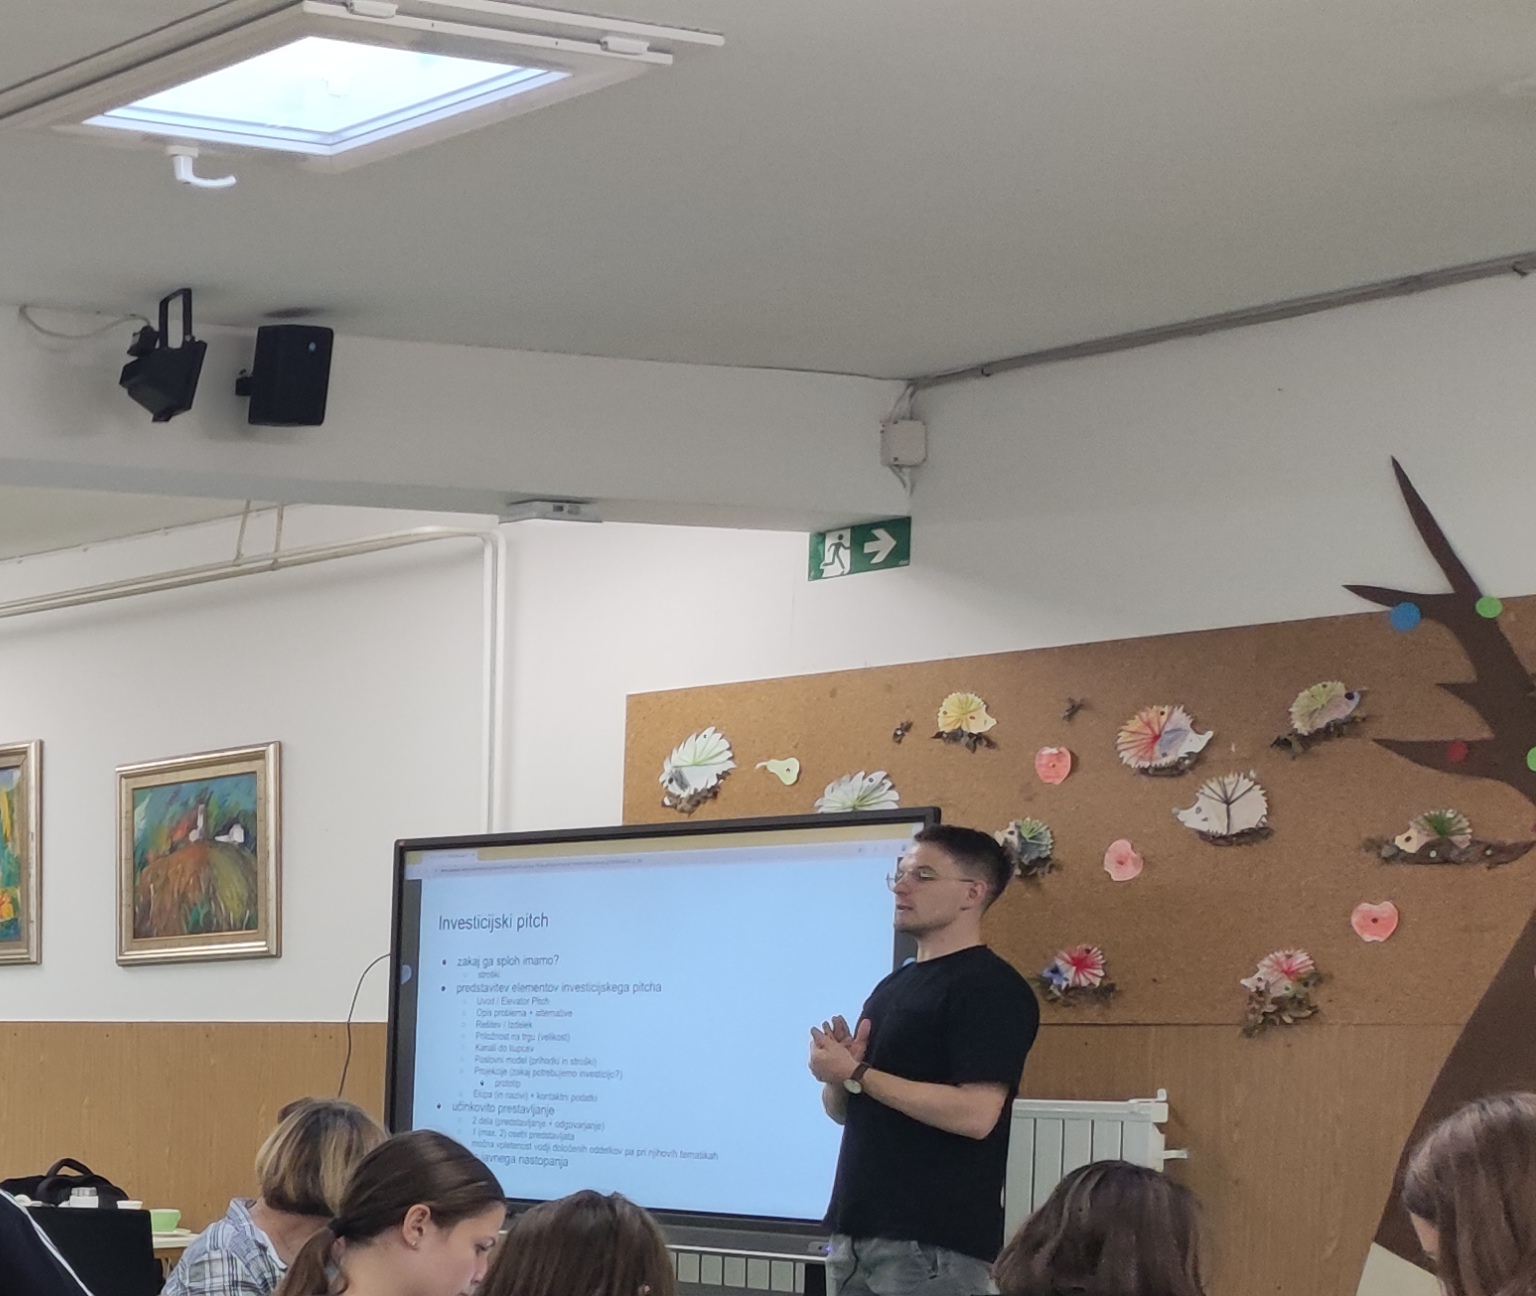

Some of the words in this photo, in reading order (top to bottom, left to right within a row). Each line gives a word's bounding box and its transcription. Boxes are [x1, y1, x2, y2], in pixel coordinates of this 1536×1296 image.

[438, 914, 513, 933] Investicijski
[516, 912, 549, 932] pitch
[456, 955, 480, 968] zakaj
[482, 957, 494, 968] ga
[496, 955, 520, 968] sploh
[522, 954, 560, 966] imamo?
[456, 983, 509, 995] predstavitev
[511, 983, 559, 993] elementov
[561, 982, 630, 995] investicijskega
[632, 981, 662, 993] pitcha
[452, 1102, 496, 1113] učinkovito
[497, 1103, 555, 1117] prestavljanje
[519, 1155, 569, 1169] nastopanja
